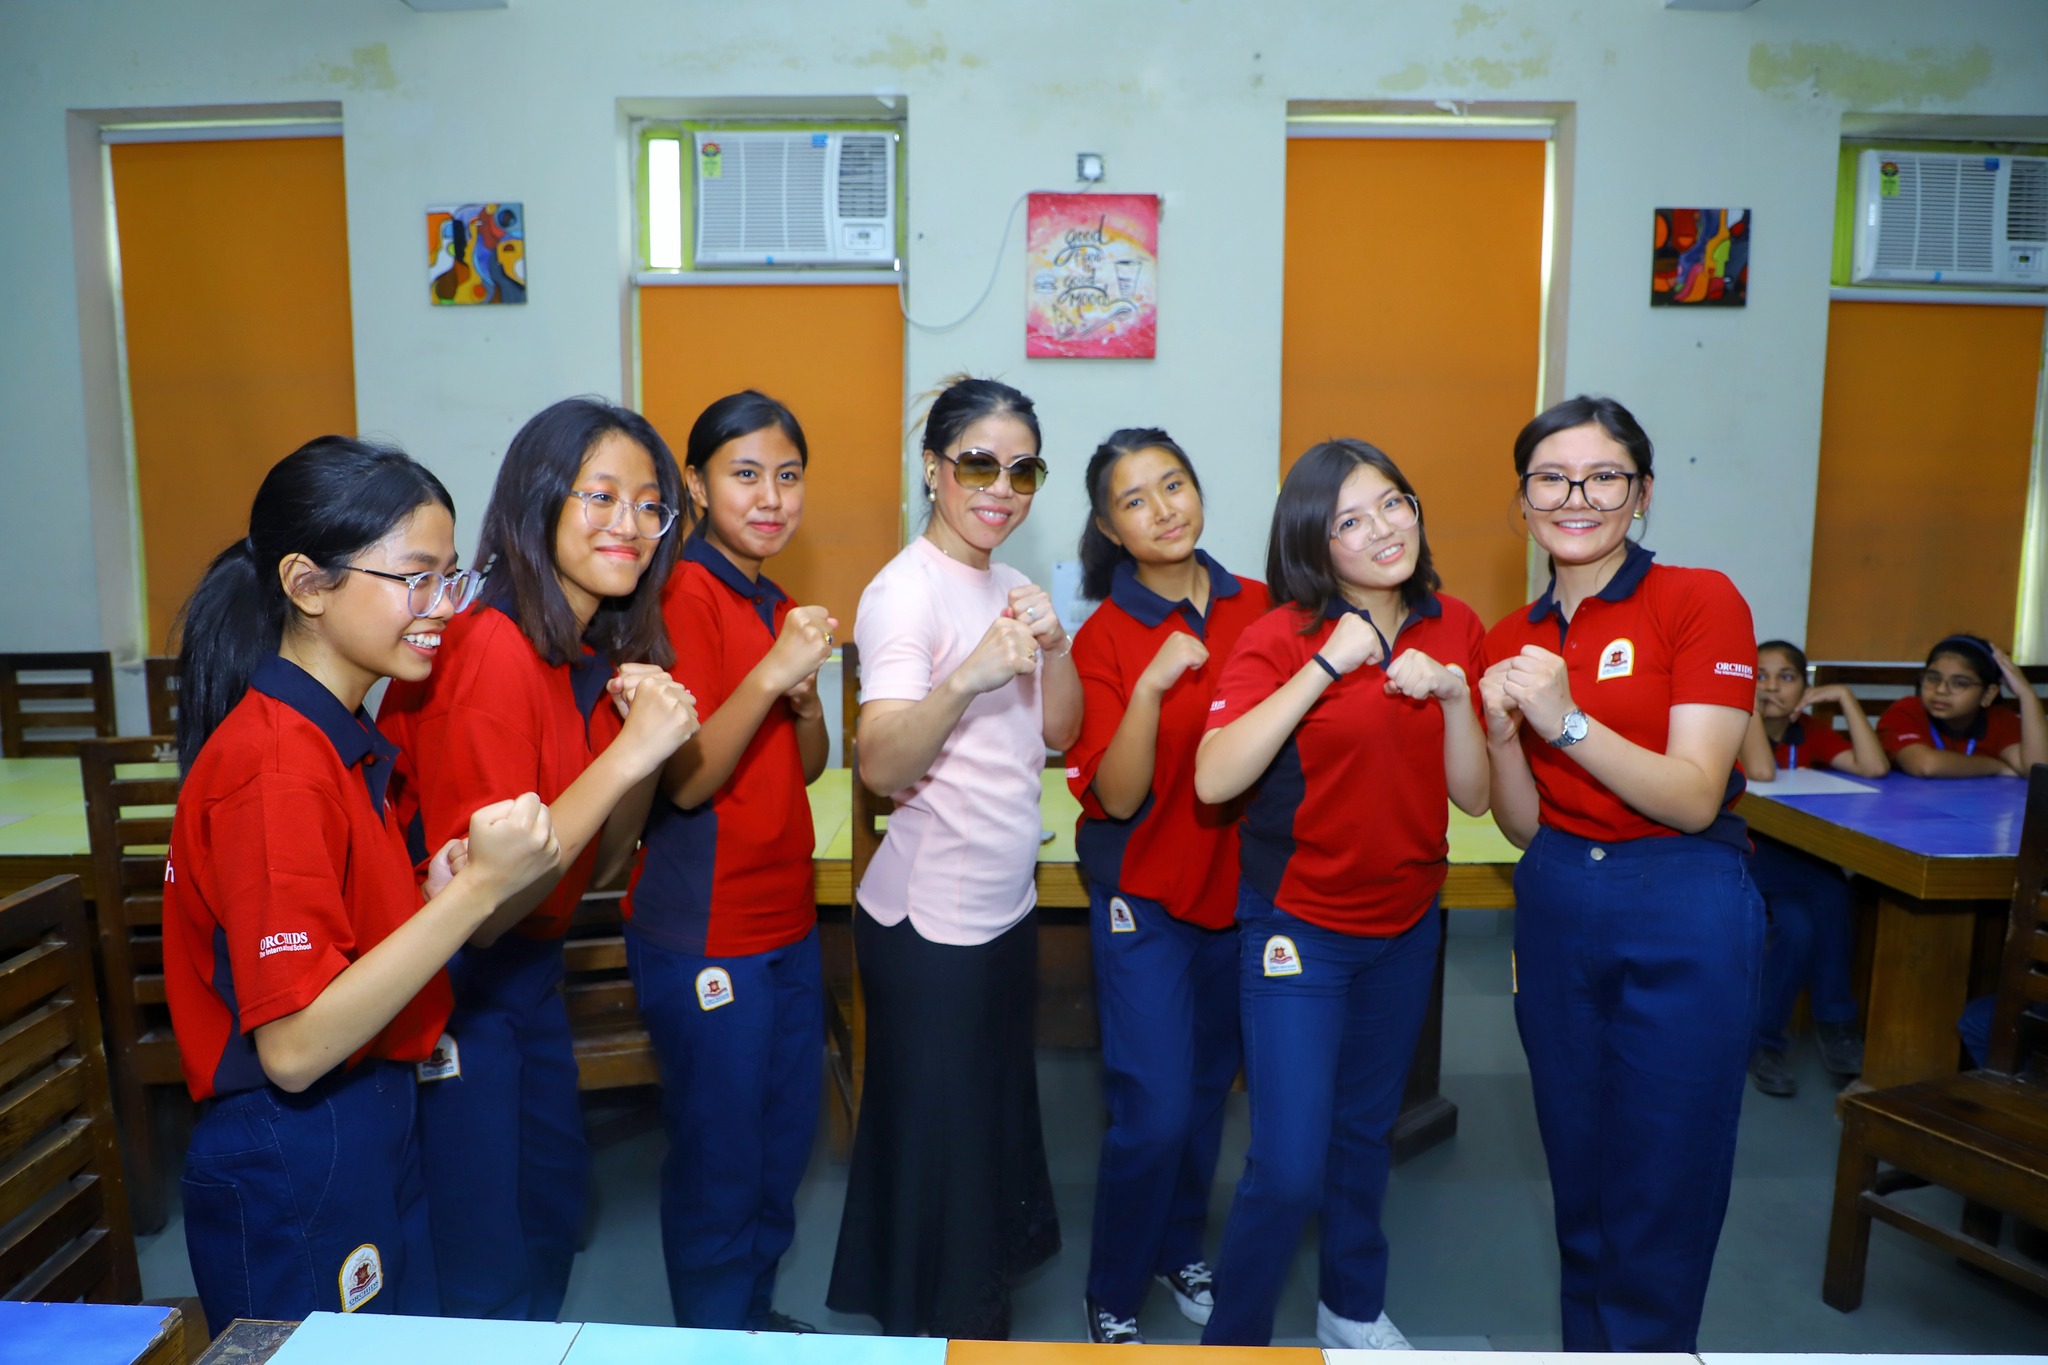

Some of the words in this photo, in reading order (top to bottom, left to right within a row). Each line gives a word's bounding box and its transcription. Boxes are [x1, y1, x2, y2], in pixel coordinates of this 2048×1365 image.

[1715, 661, 1753, 675] ORCHIDS
[260, 931, 308, 951] ORCHIDS
[293, 943, 312, 951] School
[349, 1281, 379, 1305] ORCHIDS
